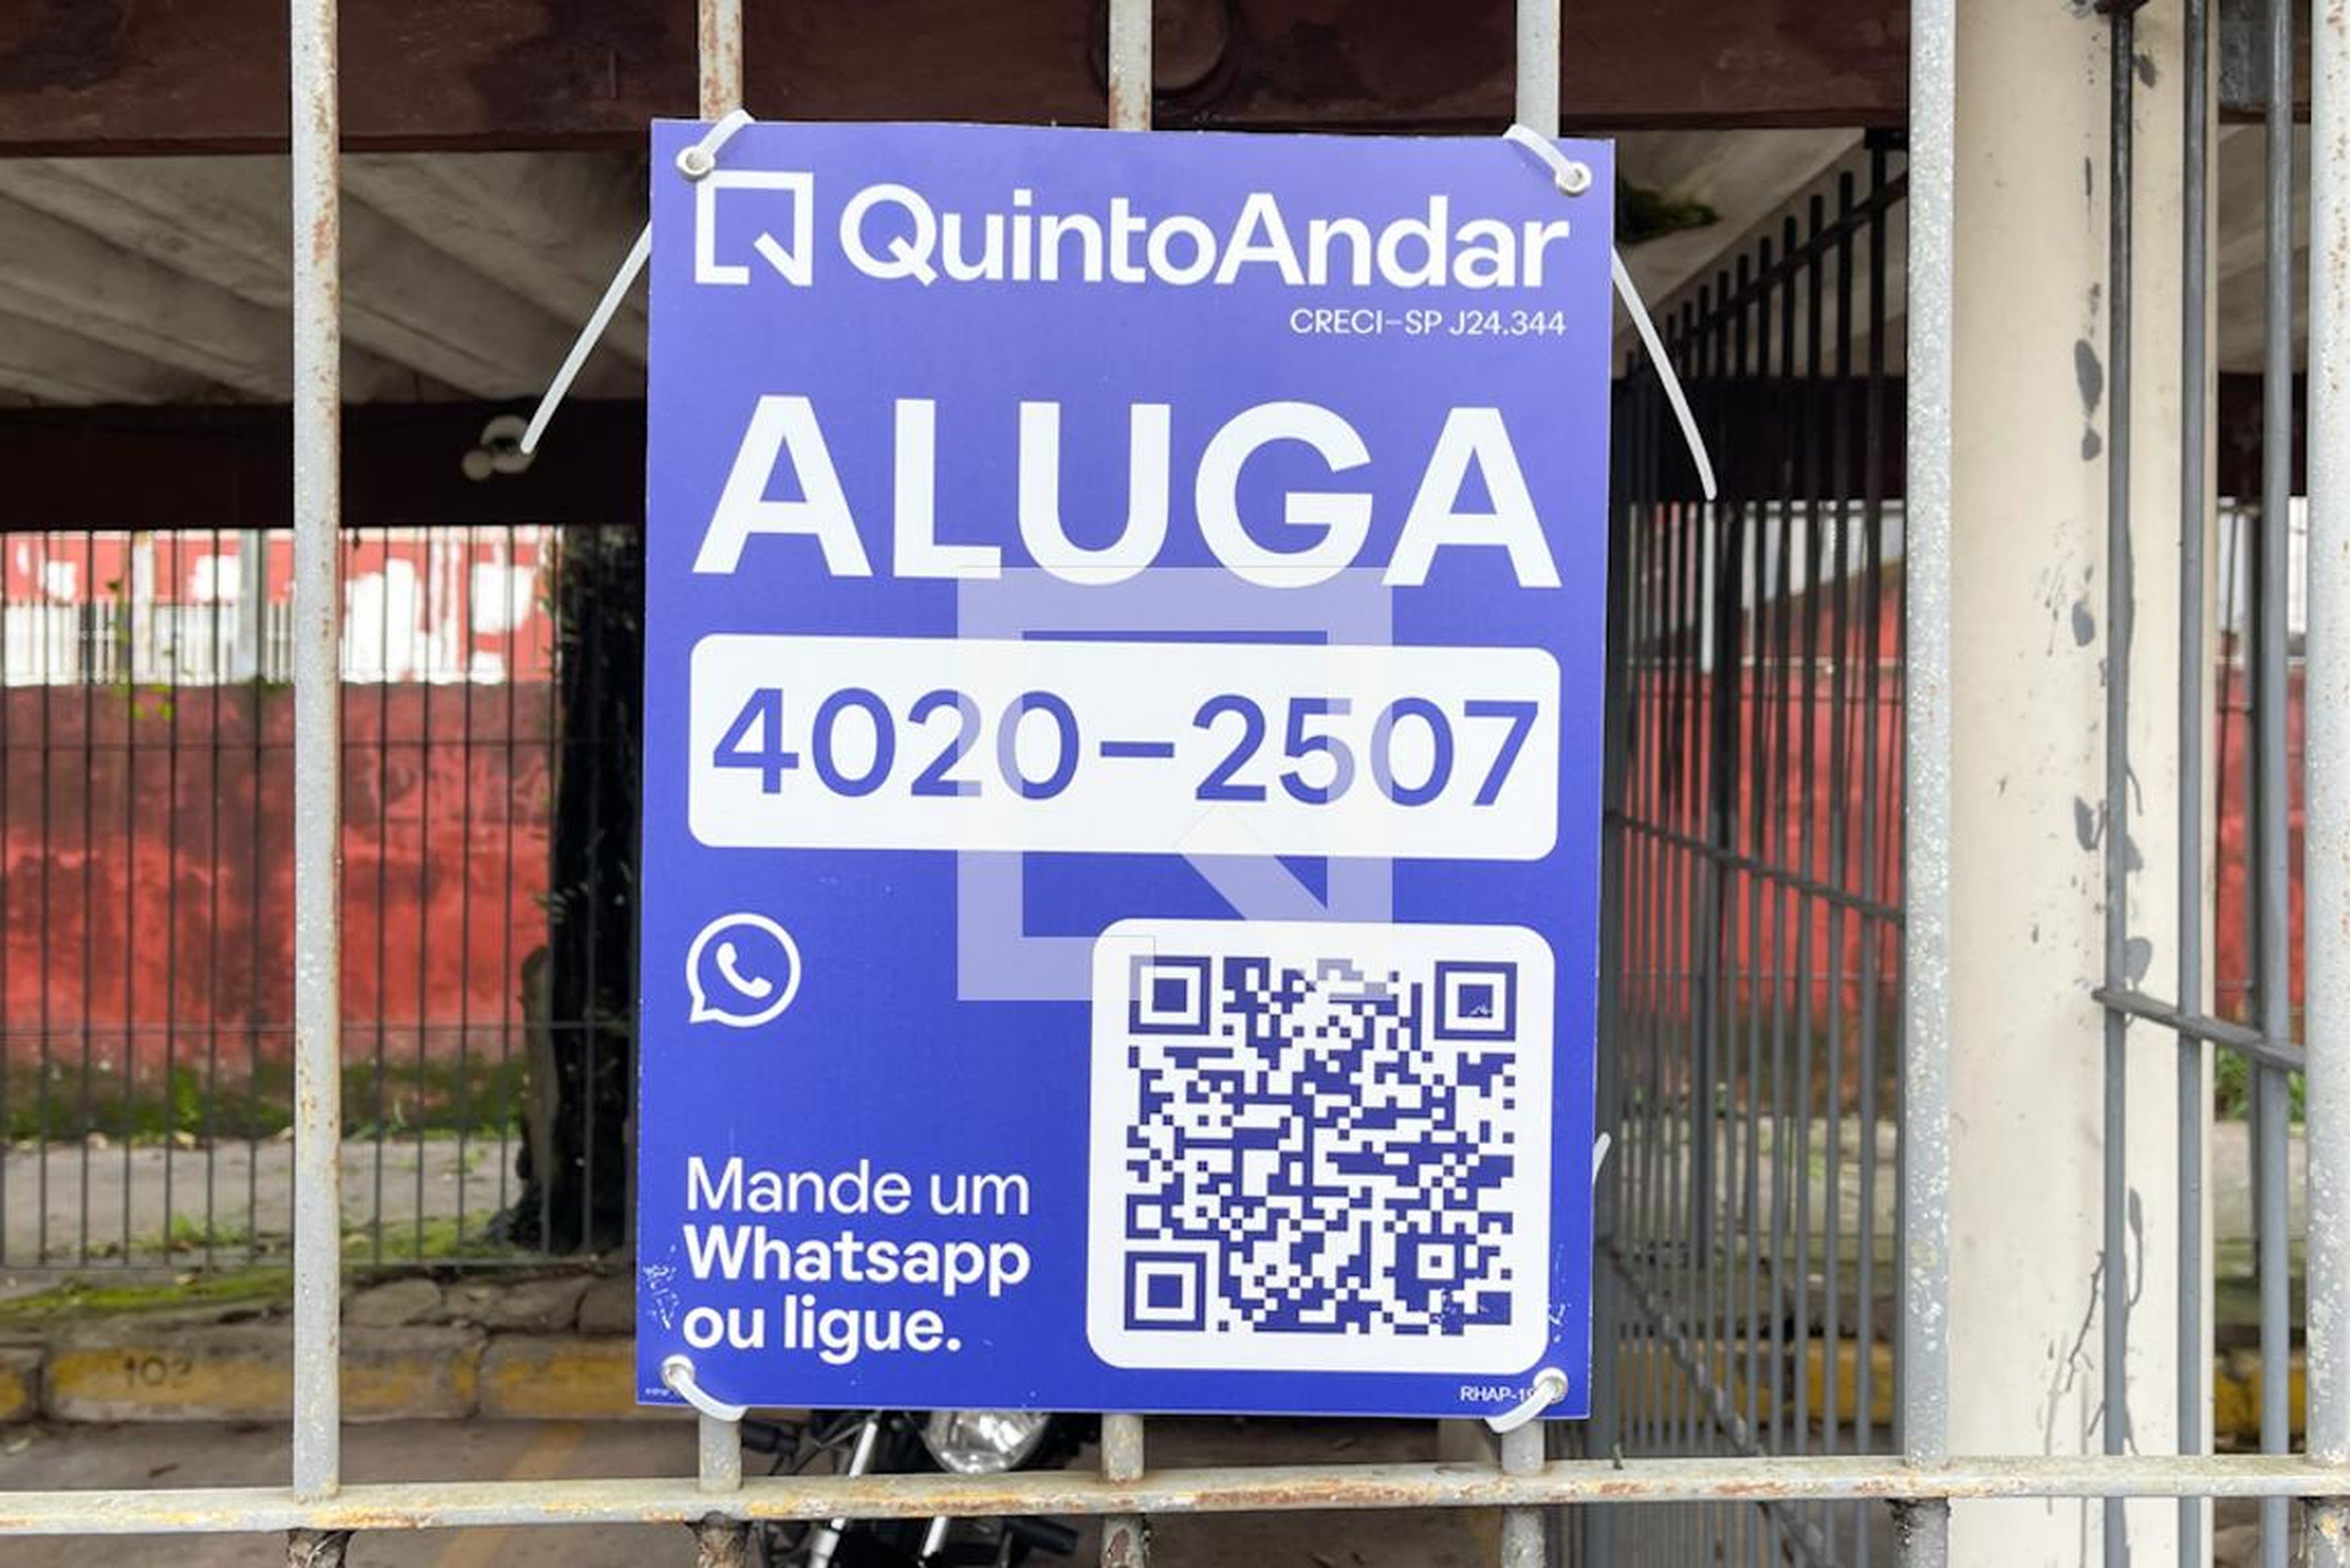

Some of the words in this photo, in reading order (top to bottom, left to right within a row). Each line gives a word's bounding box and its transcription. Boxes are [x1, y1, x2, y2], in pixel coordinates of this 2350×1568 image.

[839, 184, 1570, 288] QuintoAndar
[1289, 308, 1443, 335] CRECI-SP
[1449, 309, 1567, 337] J24.344
[692, 395, 1562, 588] ALUGA
[711, 686, 1540, 807] 4020-2507
[687, 1155, 912, 1215] Mande
[930, 1173, 1029, 1215] um
[682, 1224, 1031, 1297] Whatsapp
[682, 1306, 765, 1350] ou
[784, 1294, 961, 1365] ligue.
